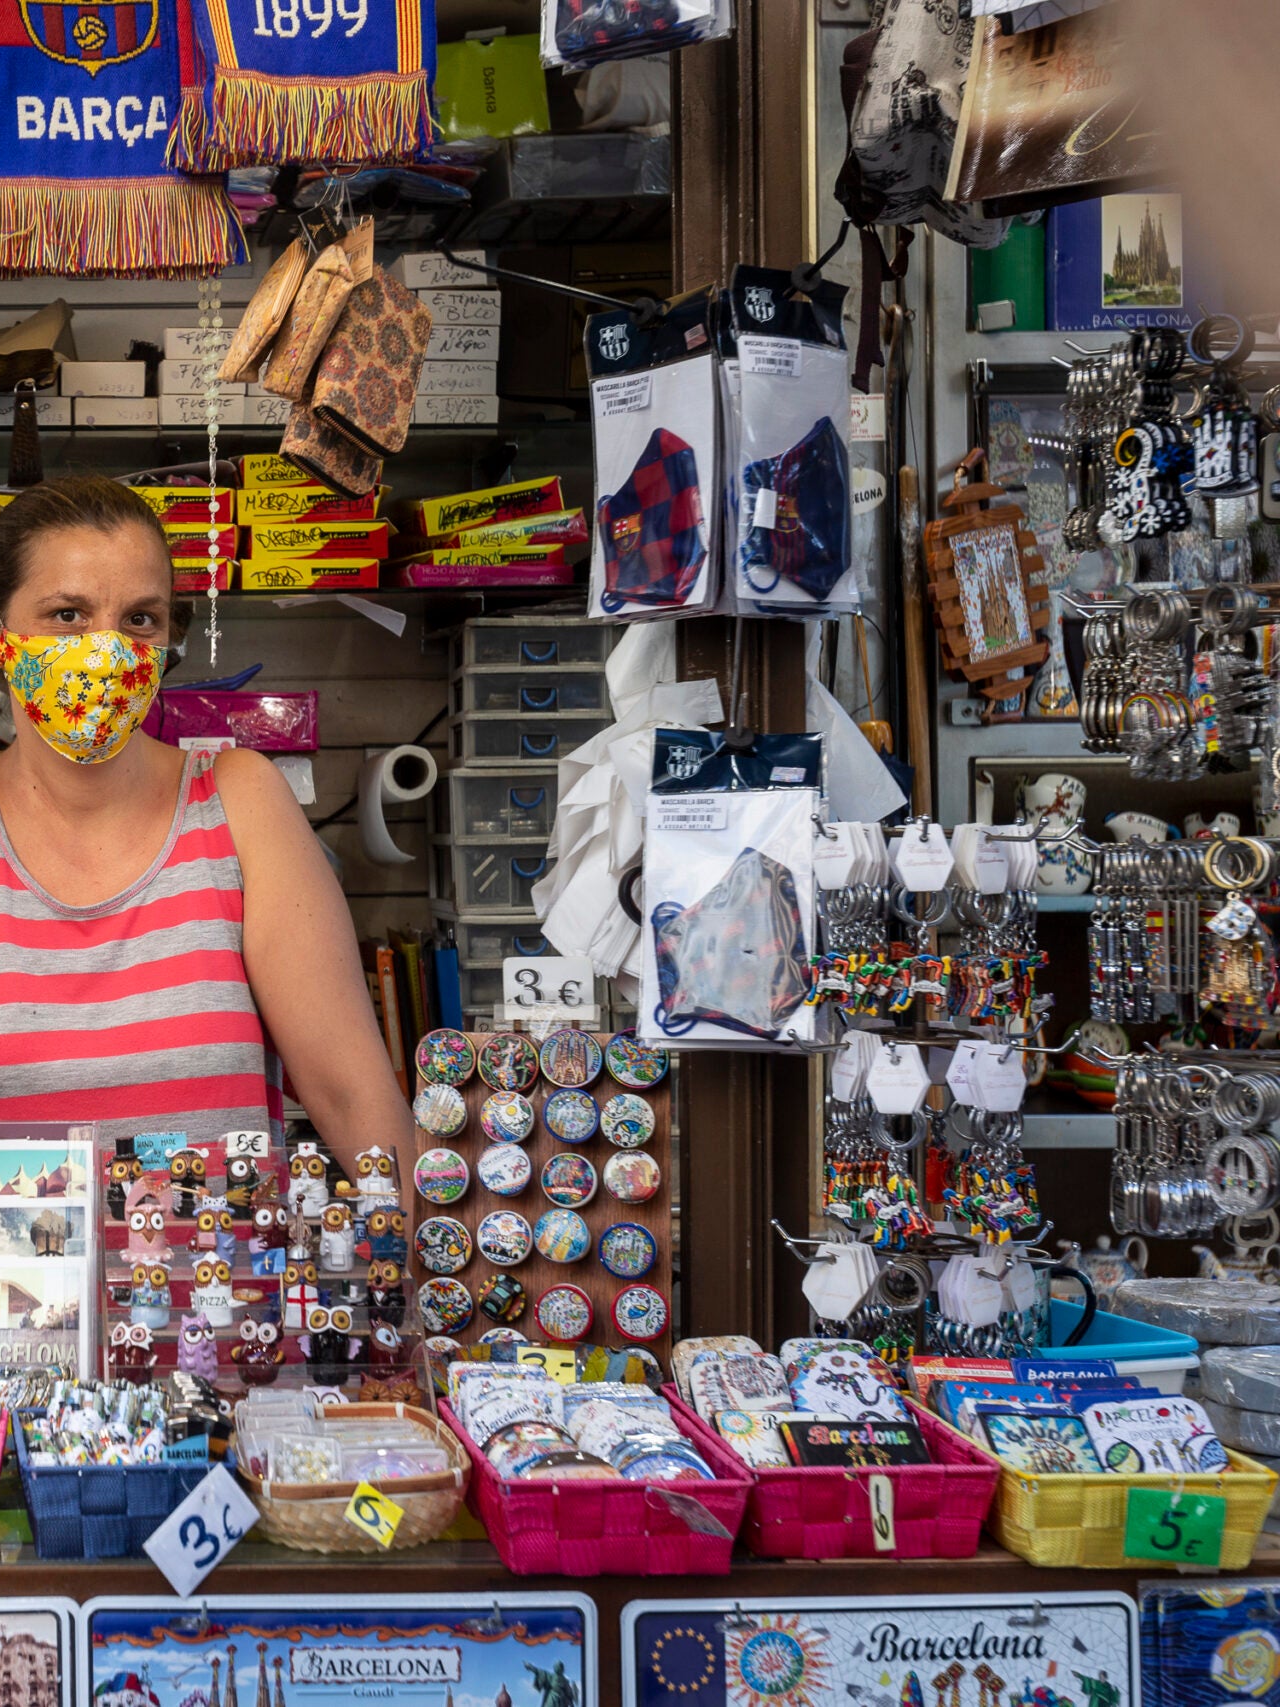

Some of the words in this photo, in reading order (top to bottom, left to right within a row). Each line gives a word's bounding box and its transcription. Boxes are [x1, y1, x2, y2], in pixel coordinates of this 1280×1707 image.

[253, 0, 368, 37] 1899
[482, 67, 497, 114] Bankia
[17, 96, 167, 147] BARÇA
[1092, 313, 1193, 328] BARCELONA
[513, 968, 544, 1008] 3
[558, 979, 583, 1008] €
[198, 1294, 229, 1308] PIZZA
[970, 1369, 1011, 1378] BARCELONA
[807, 1422, 912, 1446] Barcelona
[166, 1446, 208, 1460] BARCELONA
[865, 1620, 1047, 1665] Barcelona
[303, 1649, 447, 1681] BARCELONA
